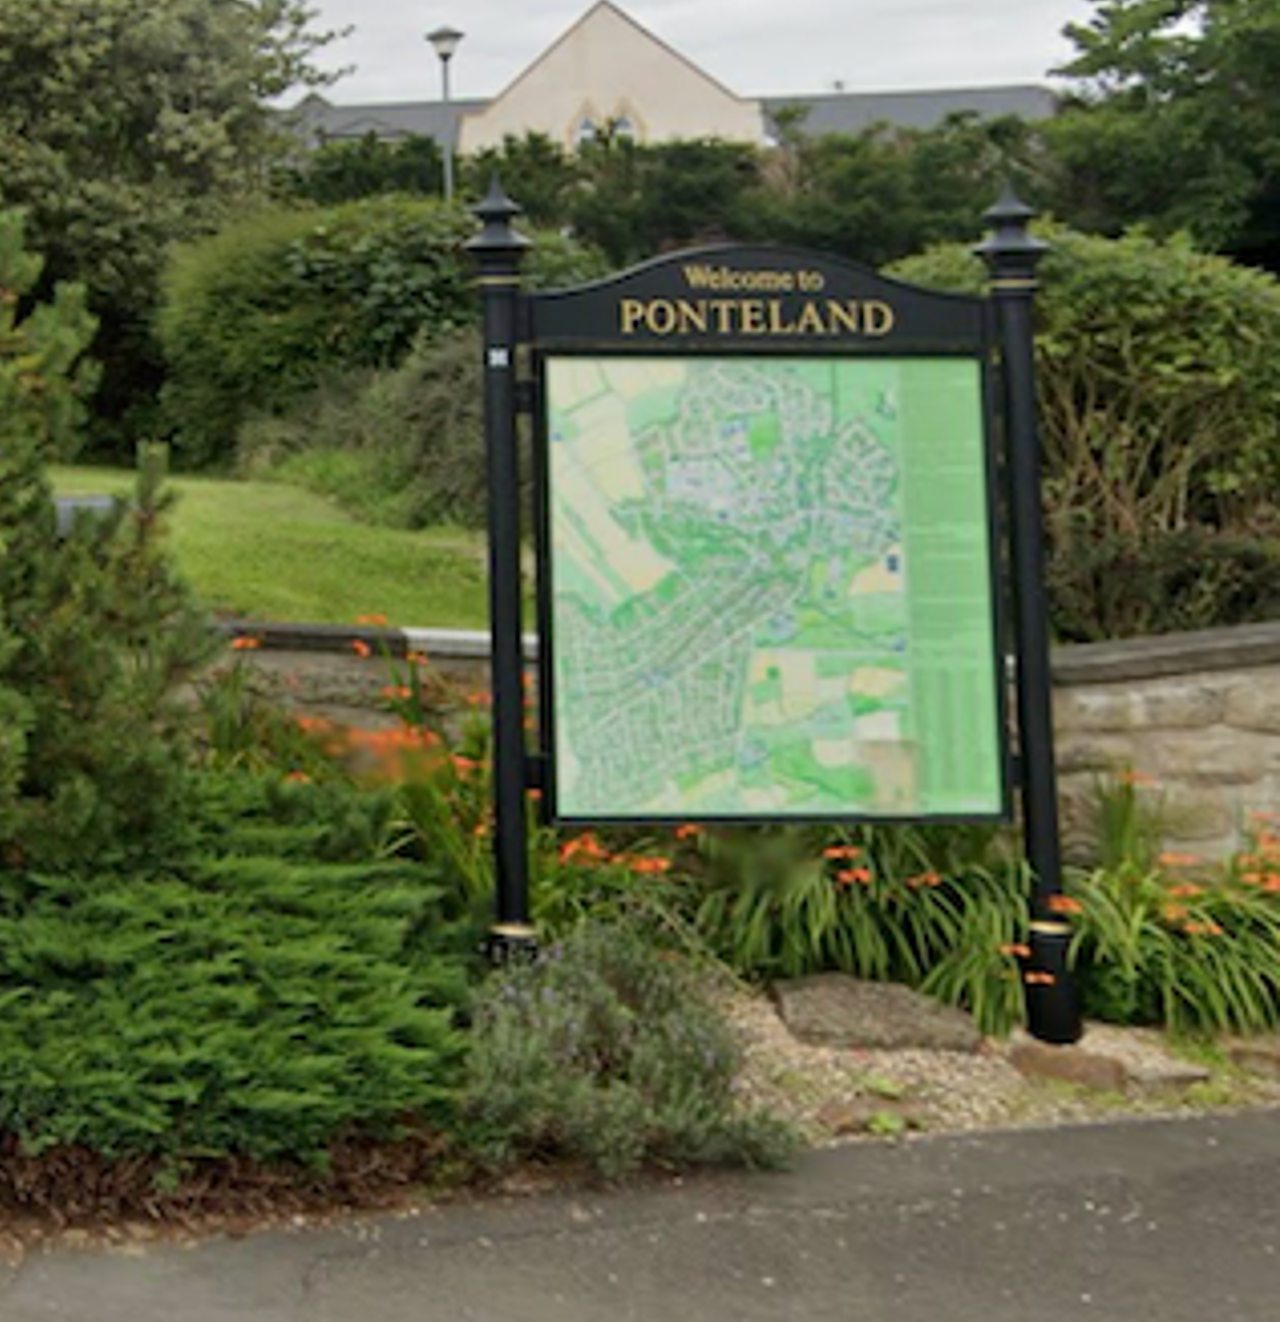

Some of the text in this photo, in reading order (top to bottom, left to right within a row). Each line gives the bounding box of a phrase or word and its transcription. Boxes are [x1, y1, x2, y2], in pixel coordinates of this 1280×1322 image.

[684, 265, 825, 291] Welcome to
[621, 299, 894, 334] PONTELAND
